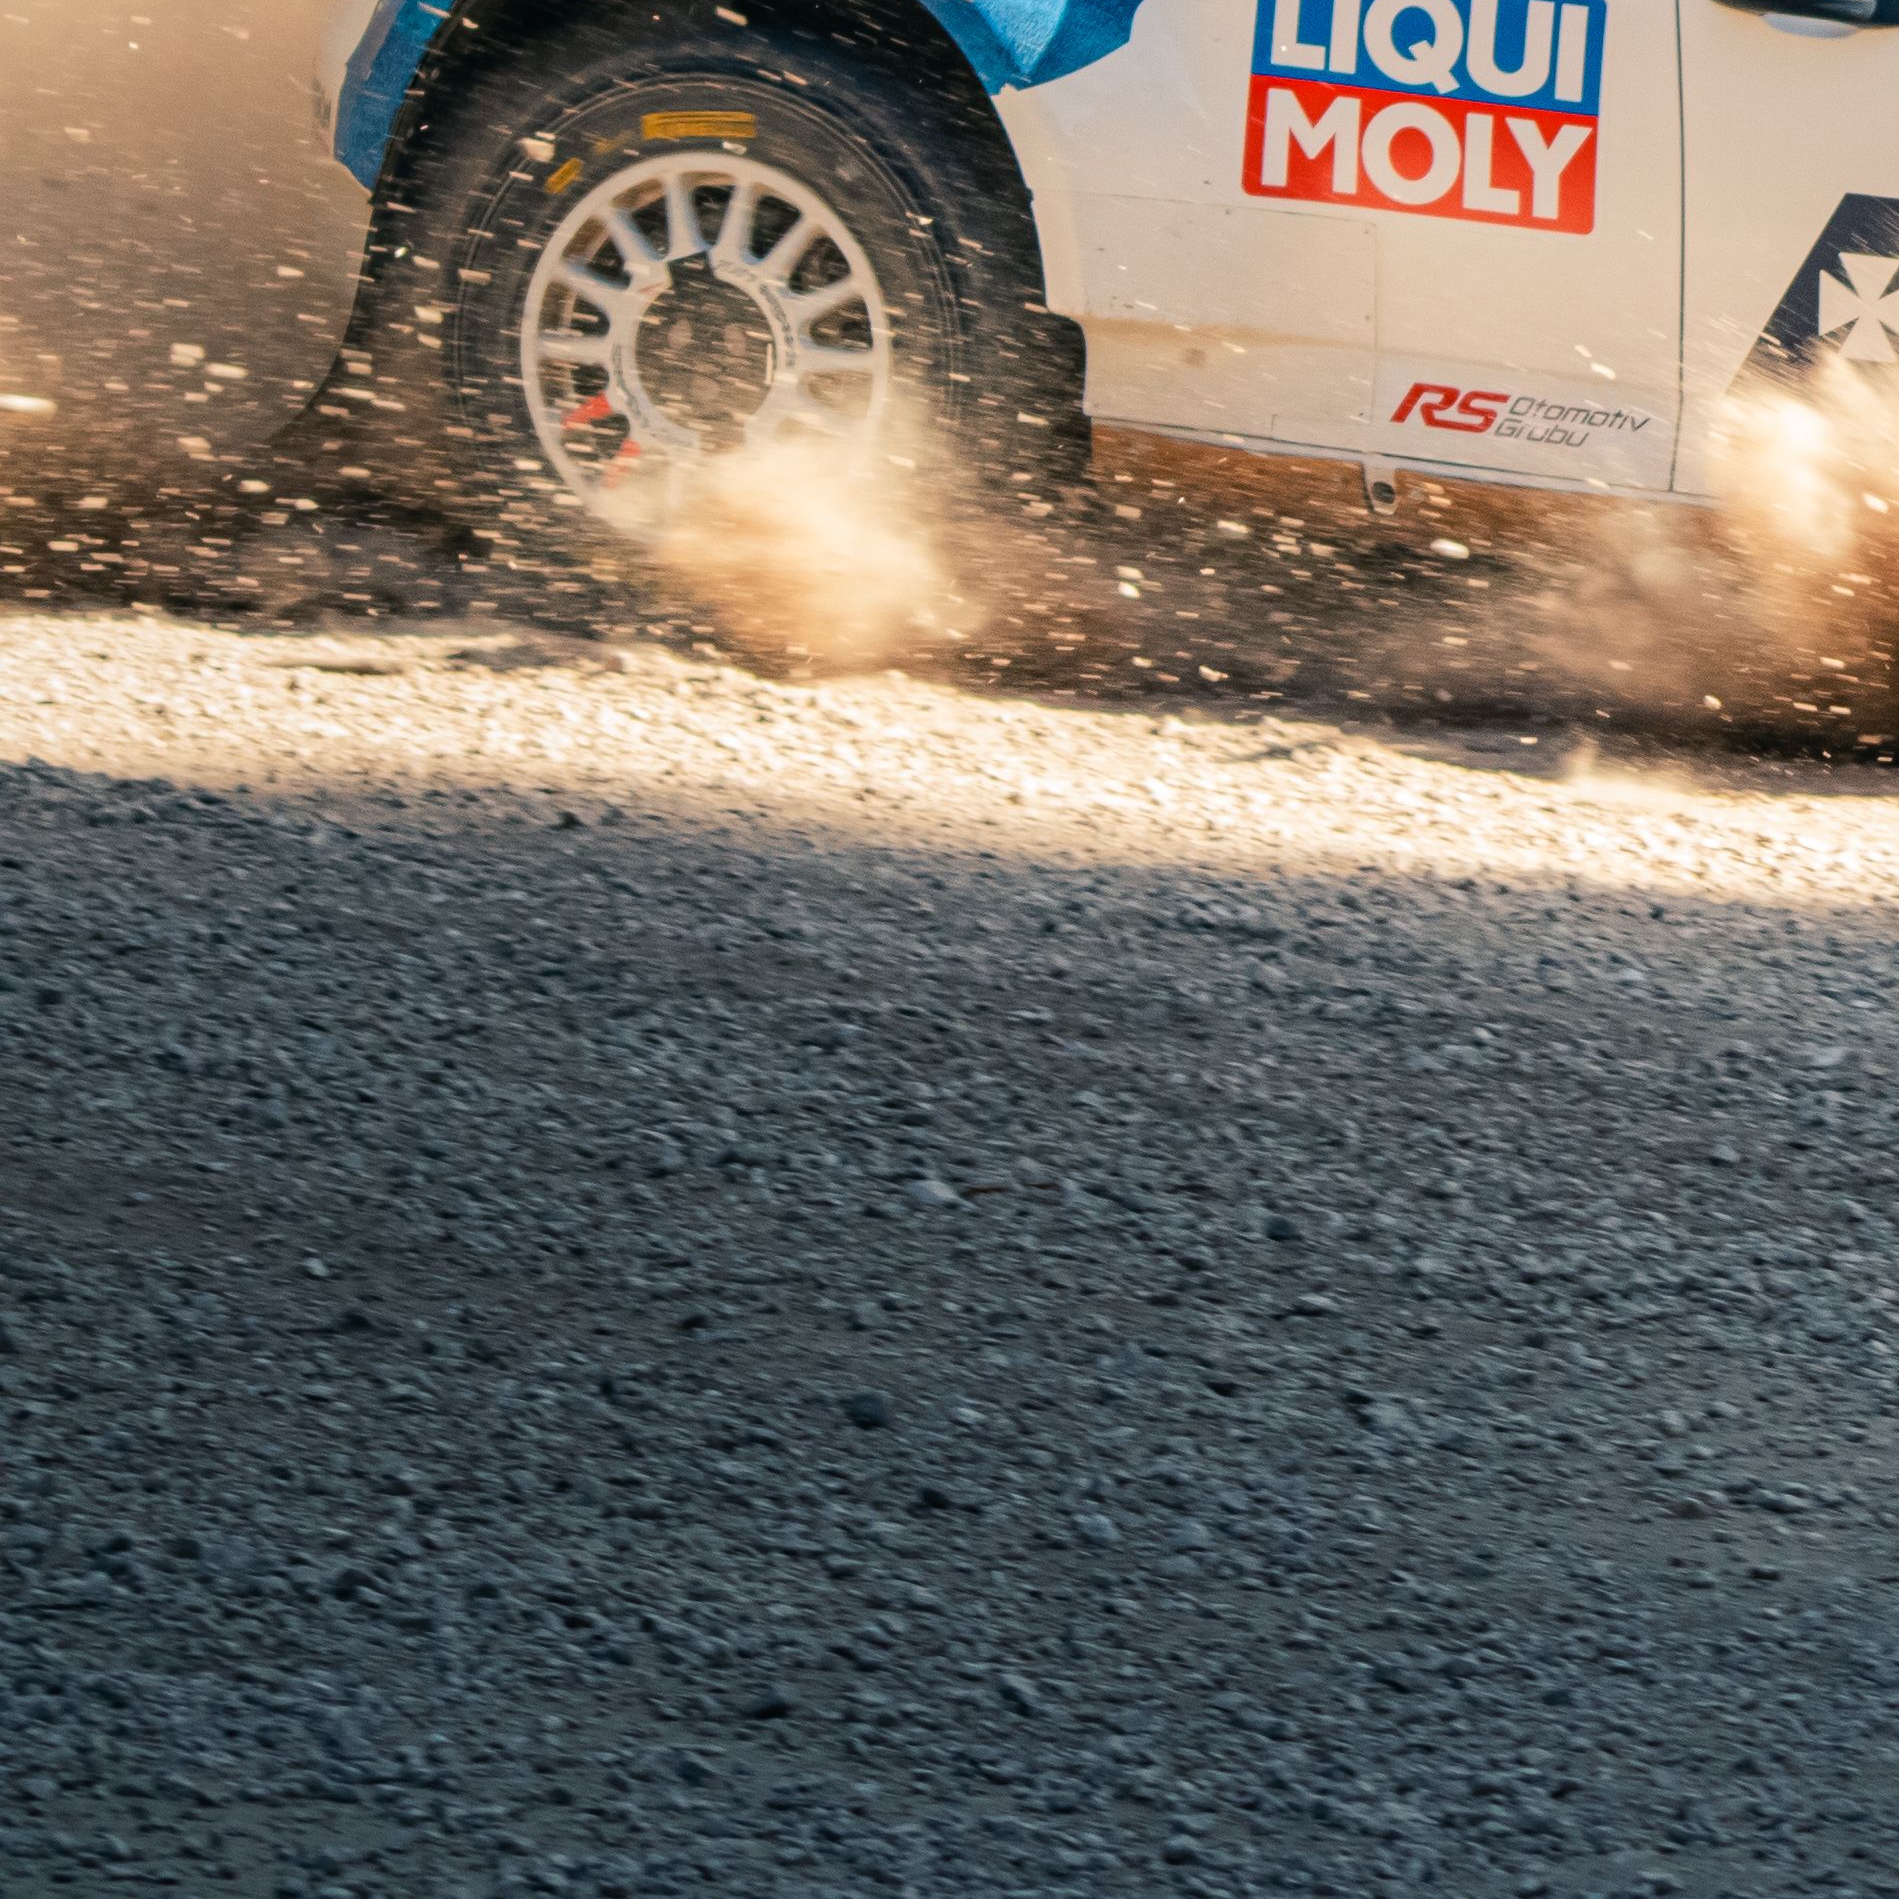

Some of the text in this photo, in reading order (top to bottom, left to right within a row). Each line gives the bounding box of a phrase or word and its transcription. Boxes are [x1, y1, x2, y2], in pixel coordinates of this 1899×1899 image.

[1261, 87, 1593, 221] MOLY
[1389, 382, 1651, 434] RS Otomotiv
[1494, 417, 1590, 447] Grubu
